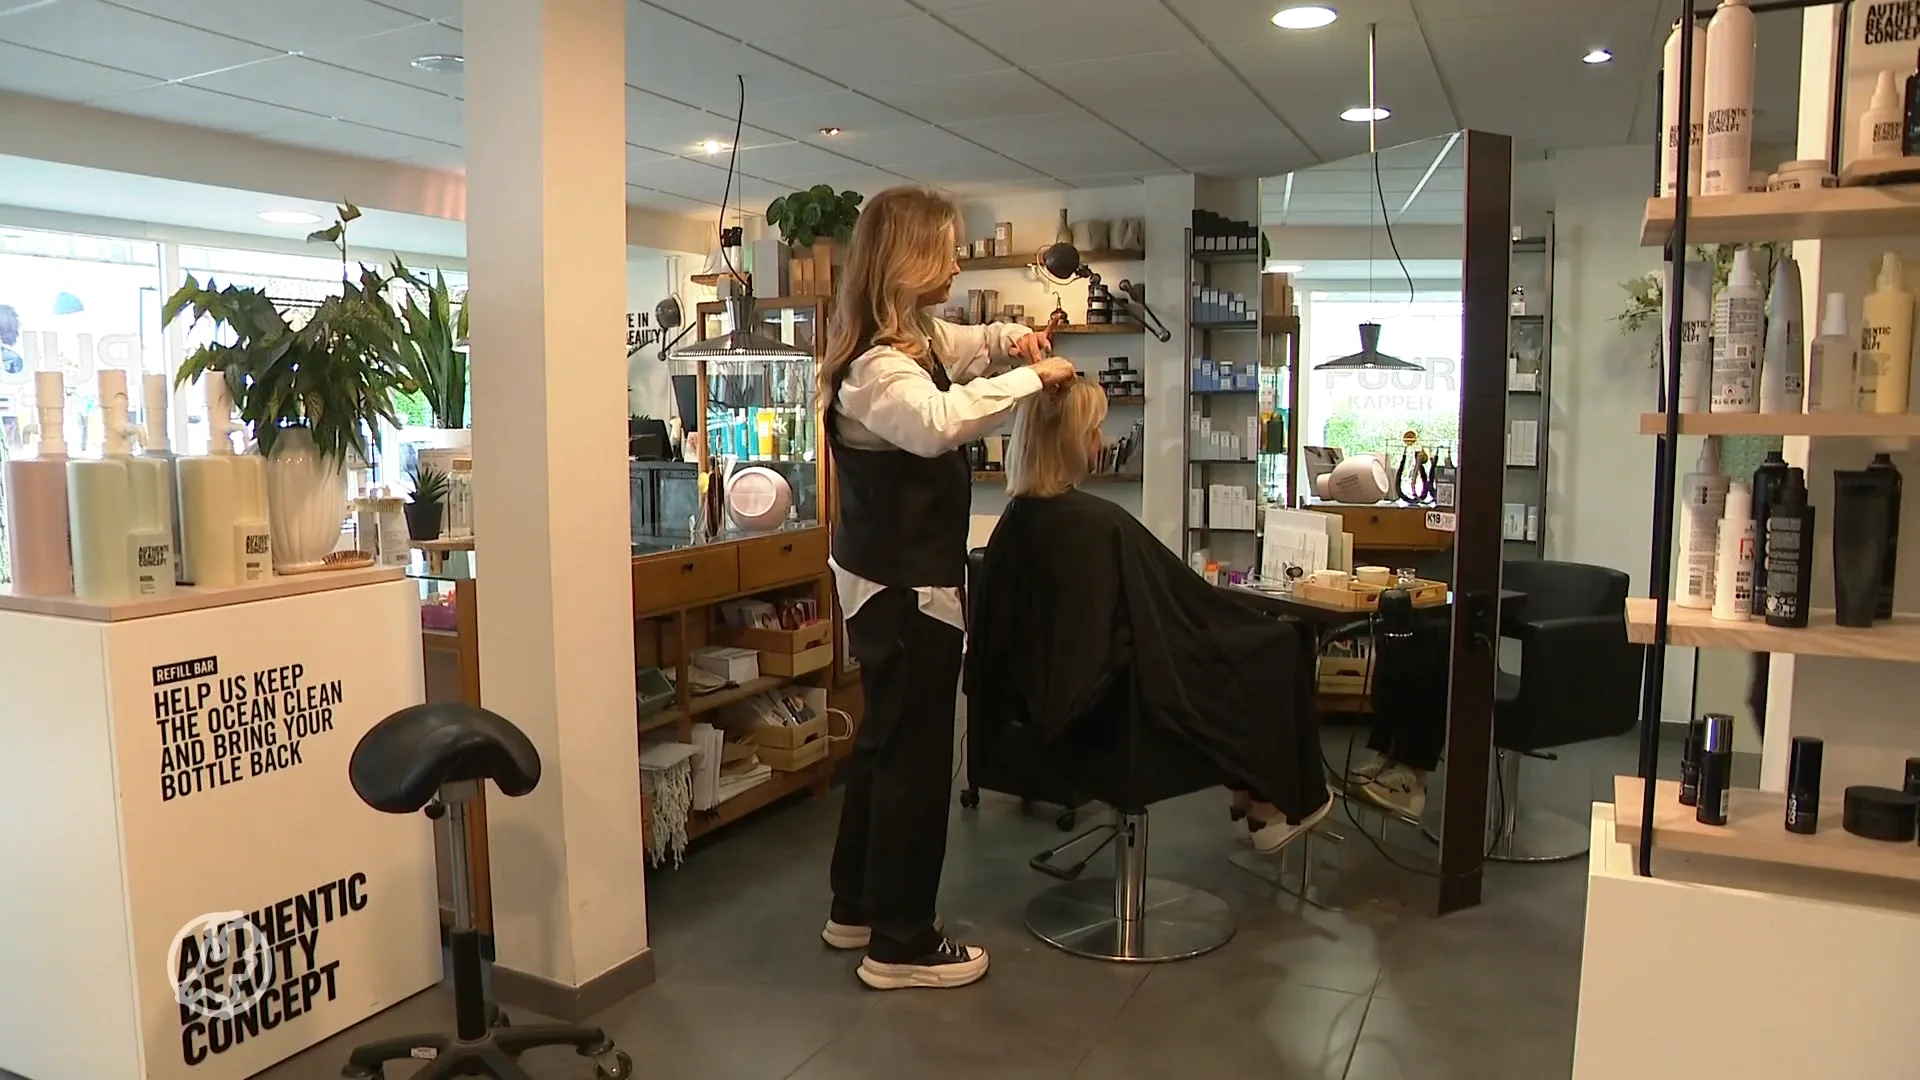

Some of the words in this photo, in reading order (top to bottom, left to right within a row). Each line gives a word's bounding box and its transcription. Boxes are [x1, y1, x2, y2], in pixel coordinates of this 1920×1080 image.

[626, 328, 661, 345] EAUTY
[638, 312, 649, 327] IN
[1348, 395, 1432, 410] KAPPER
[154, 682, 211, 719] HELP
[219, 675, 247, 704] US
[253, 663, 304, 697] KEEP
[156, 663, 192, 683] REFILL
[193, 659, 215, 675] BAR
[156, 712, 201, 745] THE
[208, 695, 276, 734] OCEAN
[283, 680, 343, 716] CLEAN
[161, 739, 205, 774] AND
[213, 721, 277, 760] BRING
[283, 707, 334, 741] YOUR
[161, 756, 243, 802] BOTTLE
[250, 740, 303, 777] BACK
[178, 872, 368, 983] AUTHENTIC
[178, 928, 319, 1027] BEAUTY
[182, 959, 340, 1066] CONCEPT
